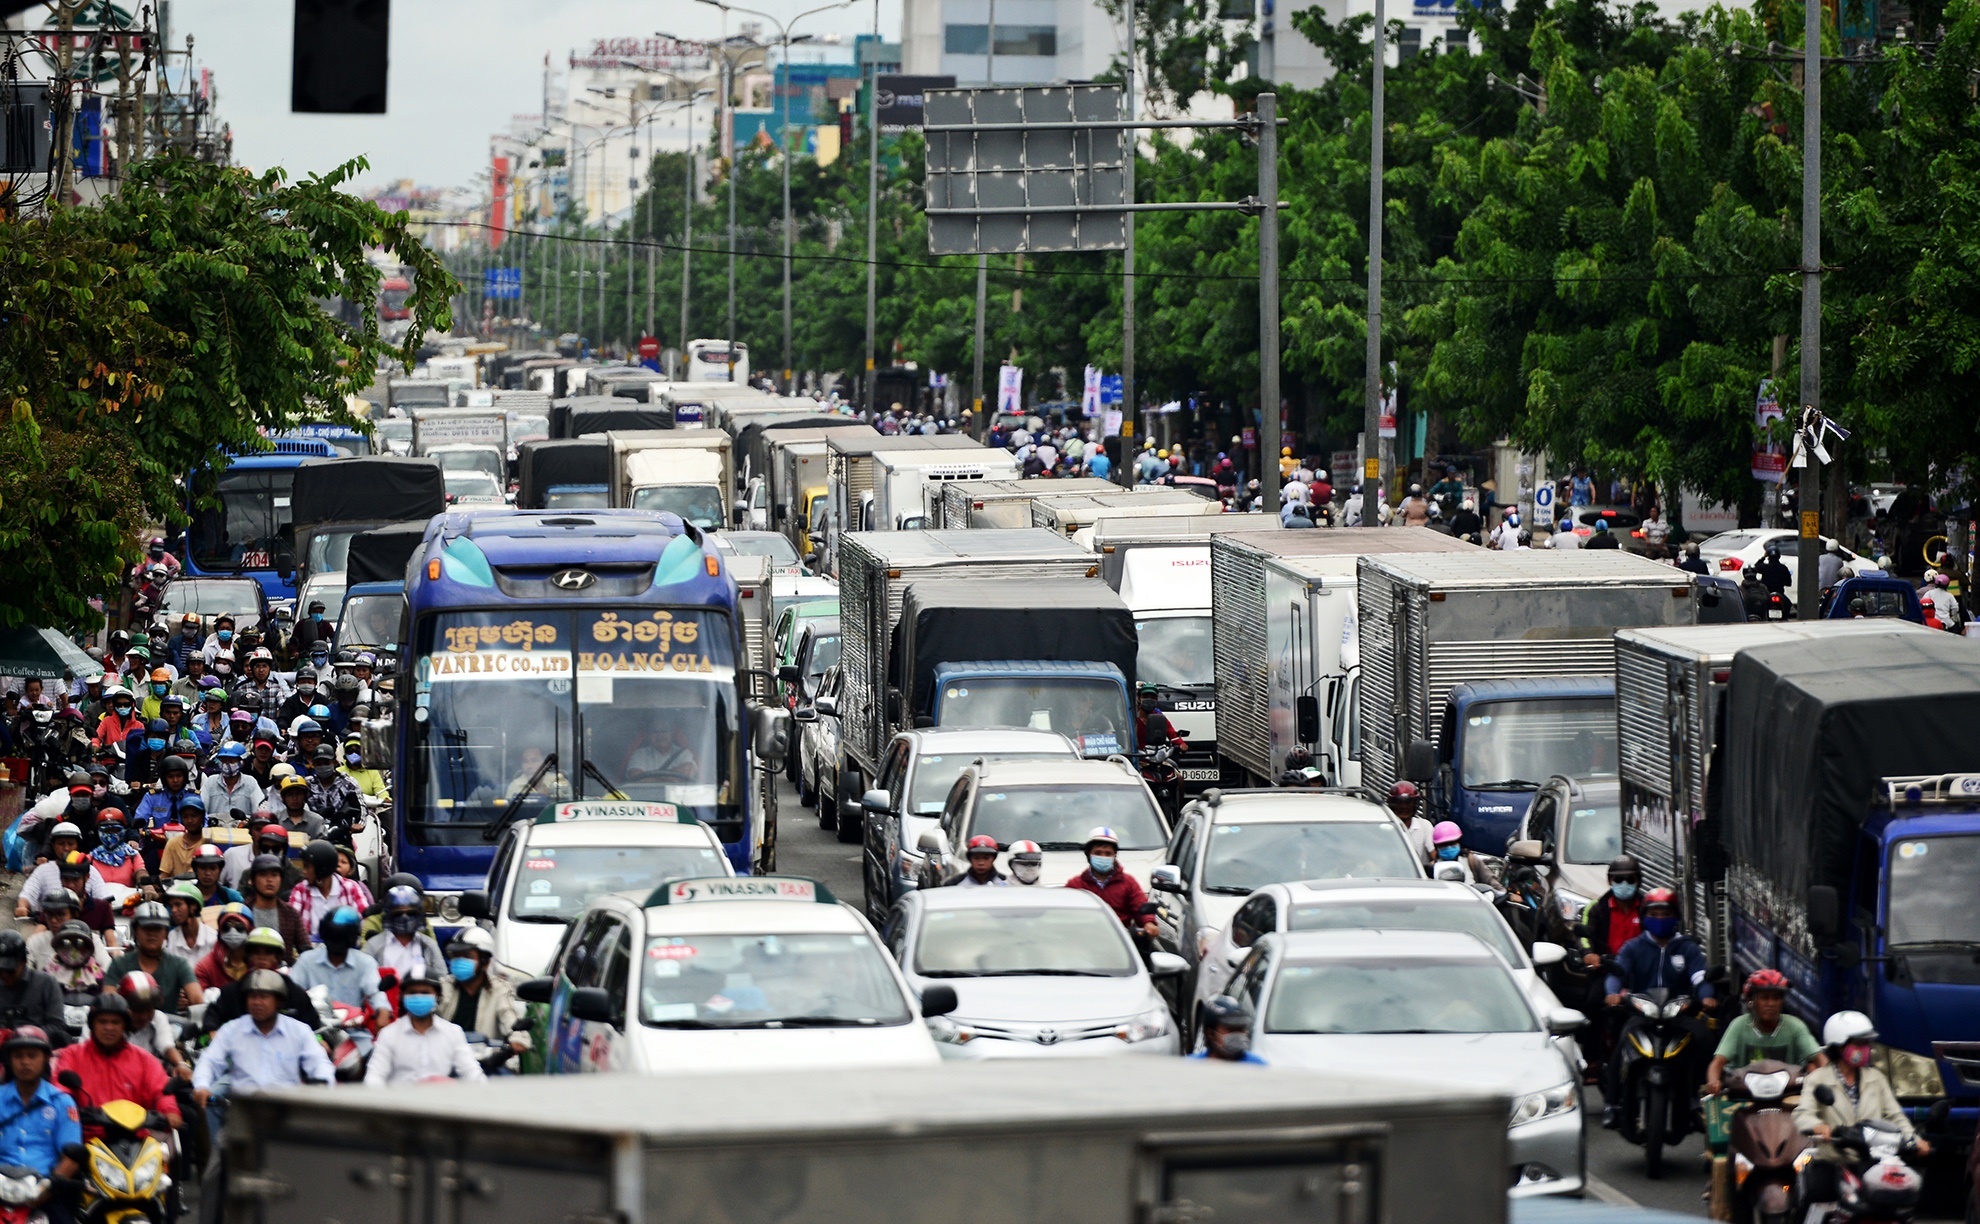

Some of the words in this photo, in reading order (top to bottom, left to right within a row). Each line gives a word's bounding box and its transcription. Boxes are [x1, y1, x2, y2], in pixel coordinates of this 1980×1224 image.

[431, 653, 507, 675] VANREC
[578, 652, 666, 671] HOANG
[671, 653, 713, 673] GIA
[12, 665, 35, 676] Coffee
[553, 680, 568, 692] KH
[1174, 701, 1216, 710] ISUZU
[1182, 770, 1218, 780] D-050.28
